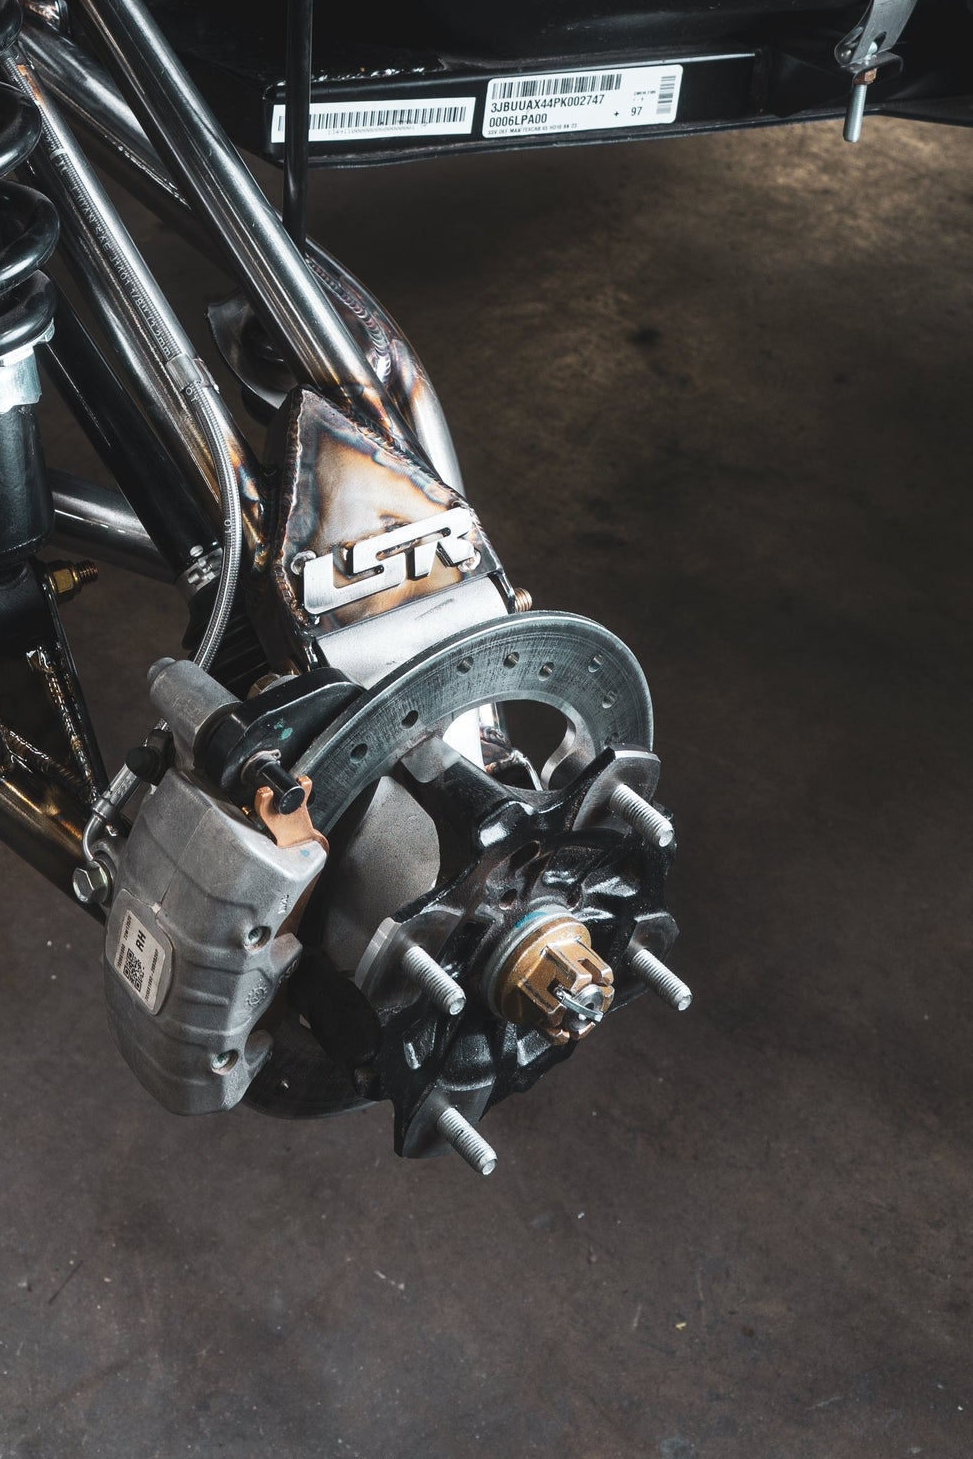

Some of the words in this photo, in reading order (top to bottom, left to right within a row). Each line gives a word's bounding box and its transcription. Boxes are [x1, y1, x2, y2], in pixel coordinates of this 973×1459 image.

[490, 94, 605, 113] 3JBUUAX44PK002747
[631, 106, 643, 116] 97
[488, 113, 548, 128] 0006LPA00
[94, 226, 112, 252] SAE
[303, 506, 474, 615] LSR
[135, 930, 146, 952] RH
